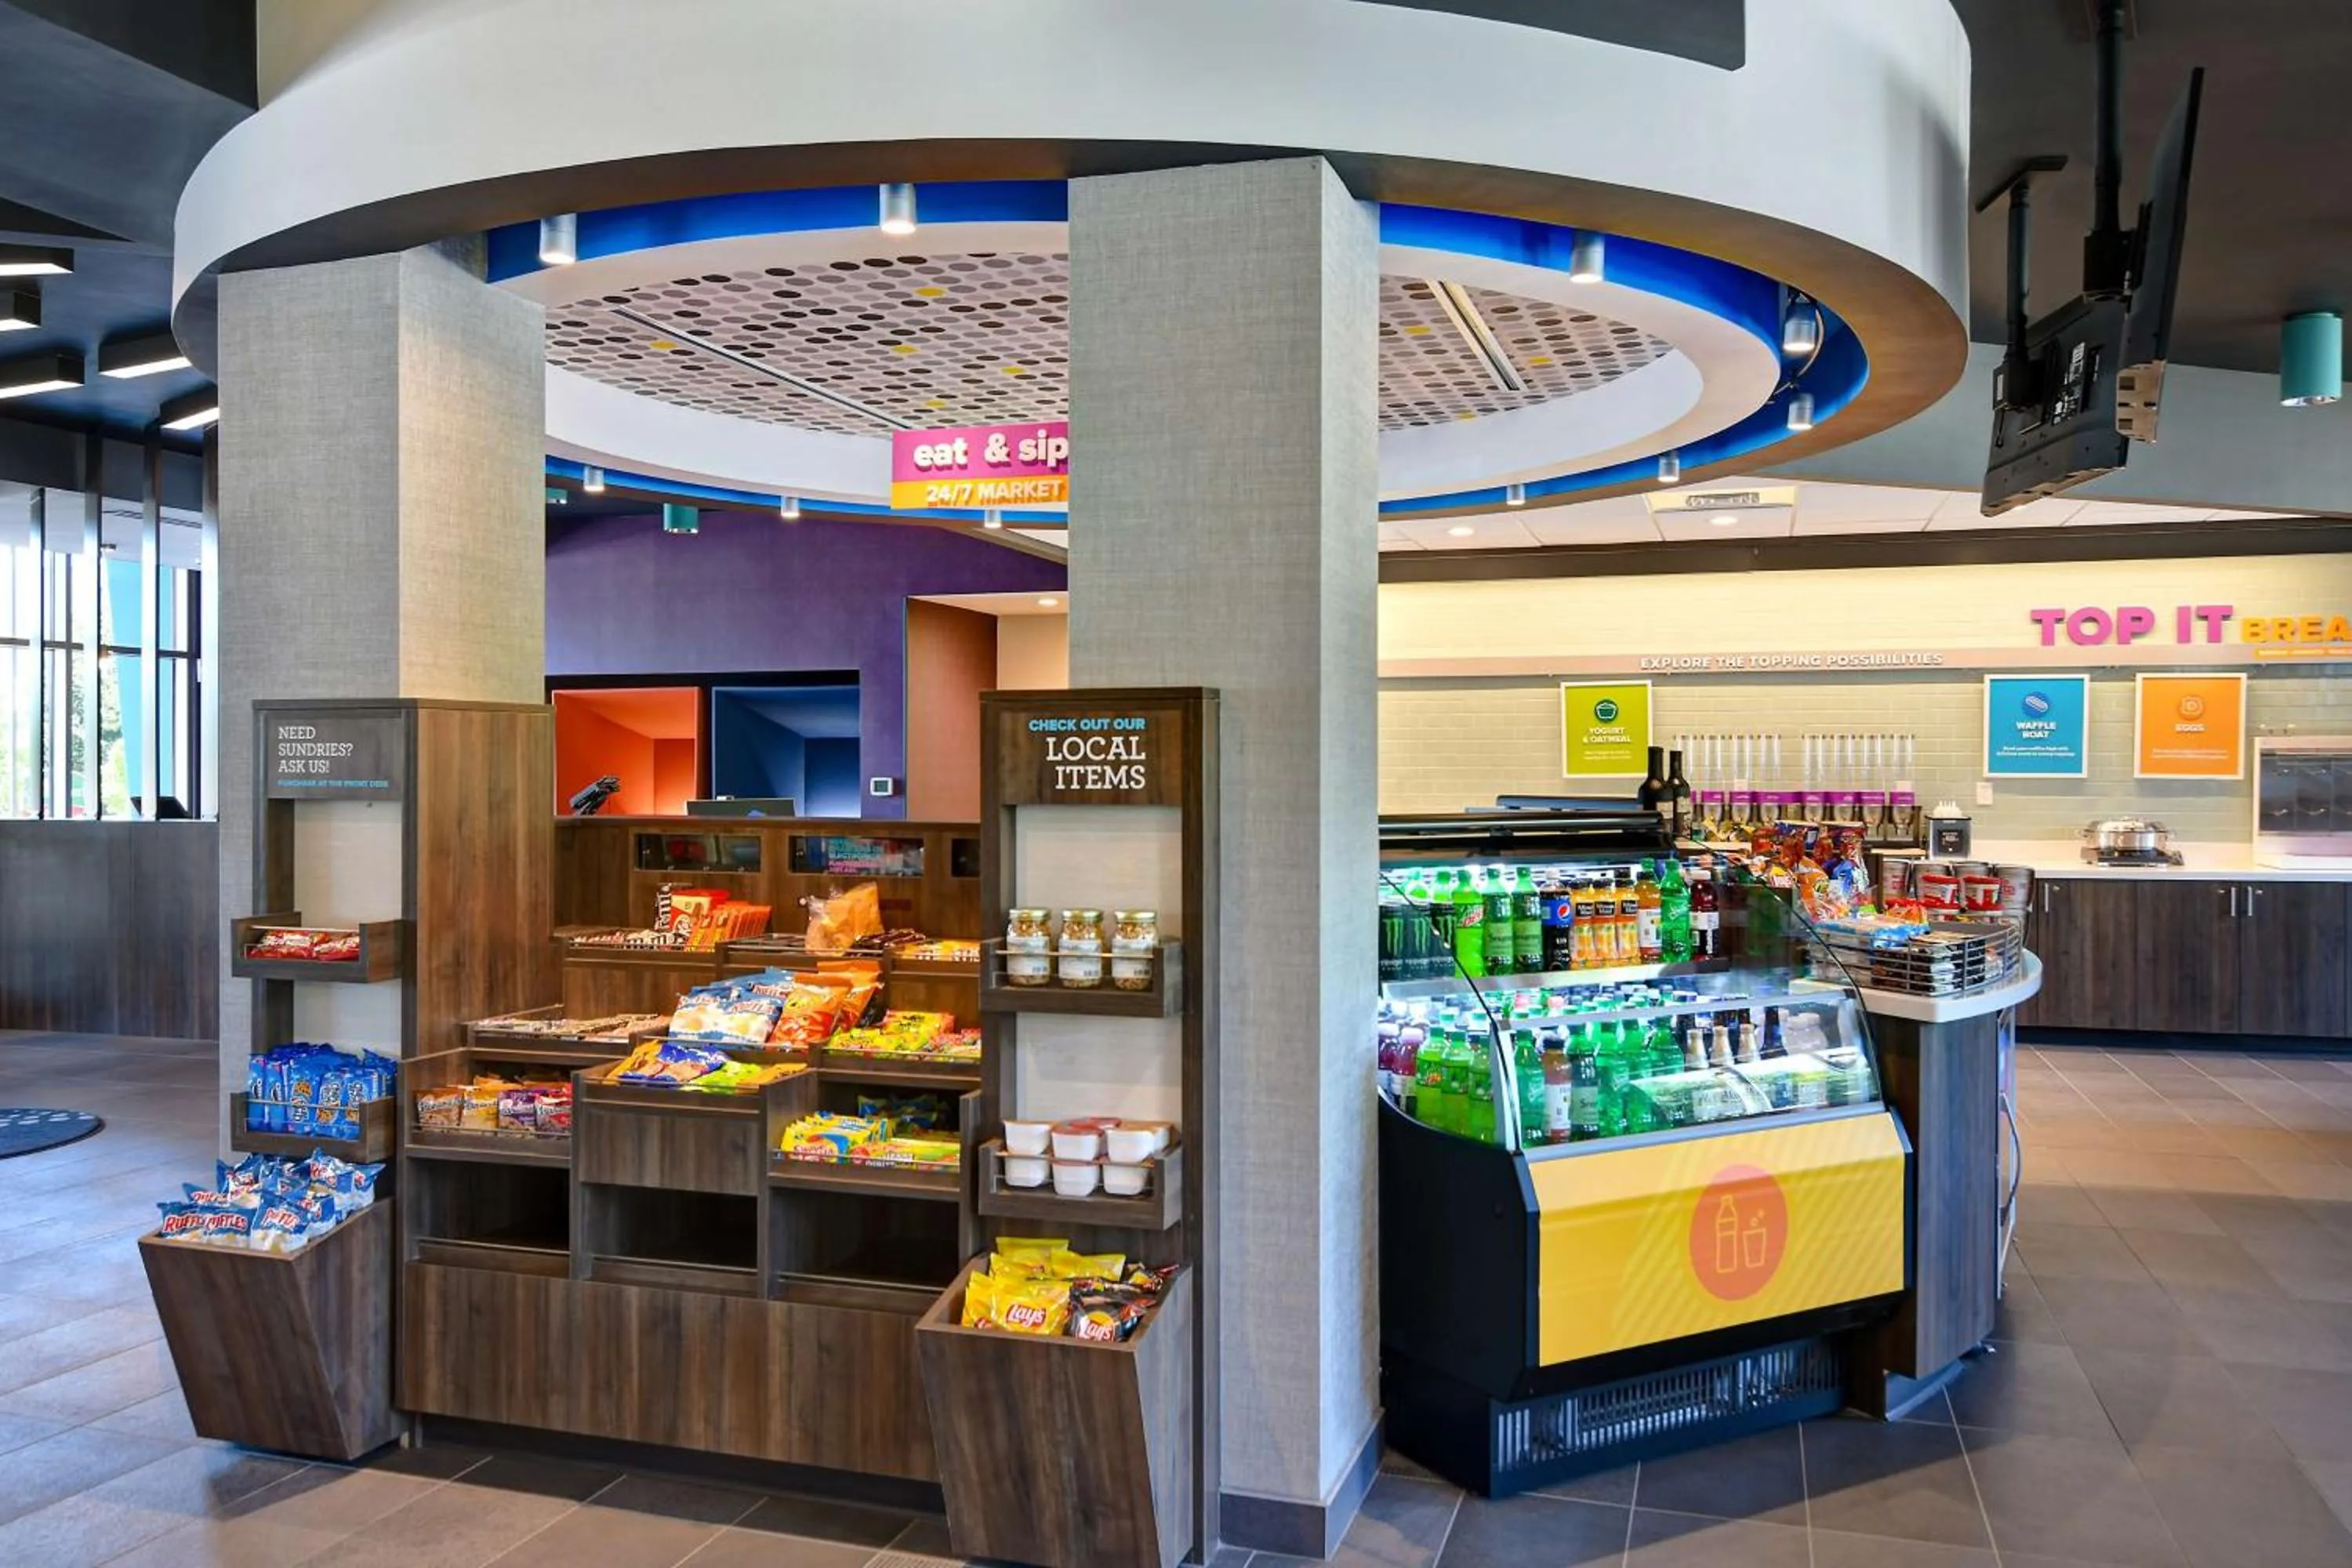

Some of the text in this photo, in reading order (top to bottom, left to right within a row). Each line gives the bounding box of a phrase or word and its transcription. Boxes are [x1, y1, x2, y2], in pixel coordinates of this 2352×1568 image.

[913, 429, 1069, 472] eat & sip
[927, 480, 1062, 504] 24/7 MARKET
[2031, 604, 2234, 647] TOP IT
[1640, 652, 1944, 670] EXPLORE THE TOPPING POSSIBILITIES
[278, 726, 316, 739] NEED
[1029, 718, 1145, 731] CHECK OUT OUR
[278, 743, 353, 757] SUNDRIES?
[1046, 736, 1146, 761] LOCAL
[278, 760, 329, 773] ASK US!
[1055, 765, 1145, 789] ITEMS
